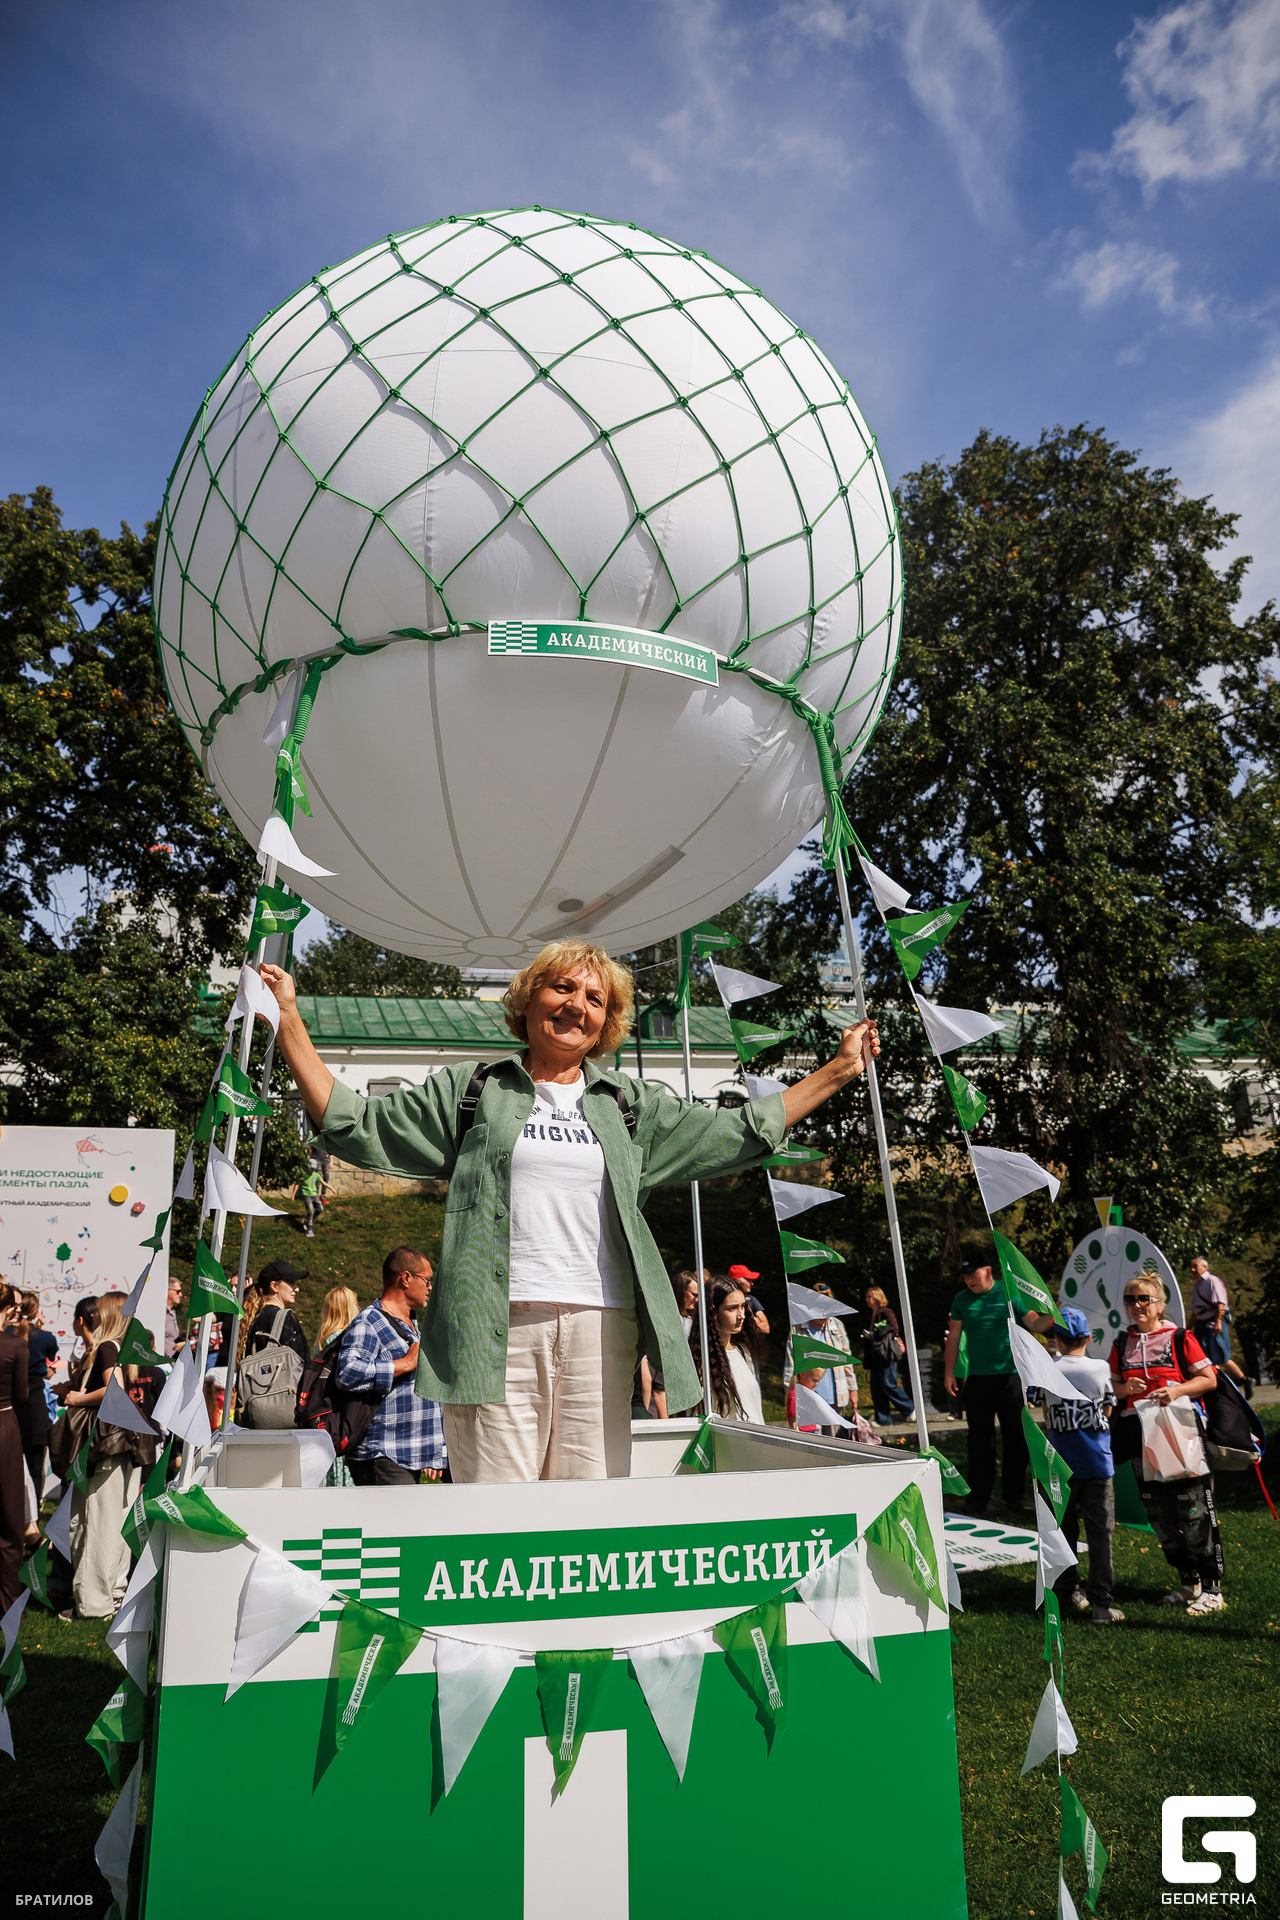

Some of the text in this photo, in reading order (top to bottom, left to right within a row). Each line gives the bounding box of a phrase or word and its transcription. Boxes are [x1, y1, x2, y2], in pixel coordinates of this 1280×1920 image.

[546, 632, 708, 673] АКАДЕМИЧЕСКИЙ
[0, 1180, 89, 1189] МЕНТЫ ПАЗЛА
[10, 1169, 104, 1179] НЕДОСТАЮЩИЕ
[26, 1200, 91, 1208] АКАДЕМИЧЕСКИЙ
[423, 1528, 835, 1602] АКАДЕМИЧЕСКИЙ
[352, 1637, 382, 1705] АКАДЕМИЧЕСКИЙ
[754, 1630, 776, 1691] АКАДЕМИЧЕСКИЙ
[565, 1676, 579, 1741] АКАДЕМИЧЕСКИЙ
